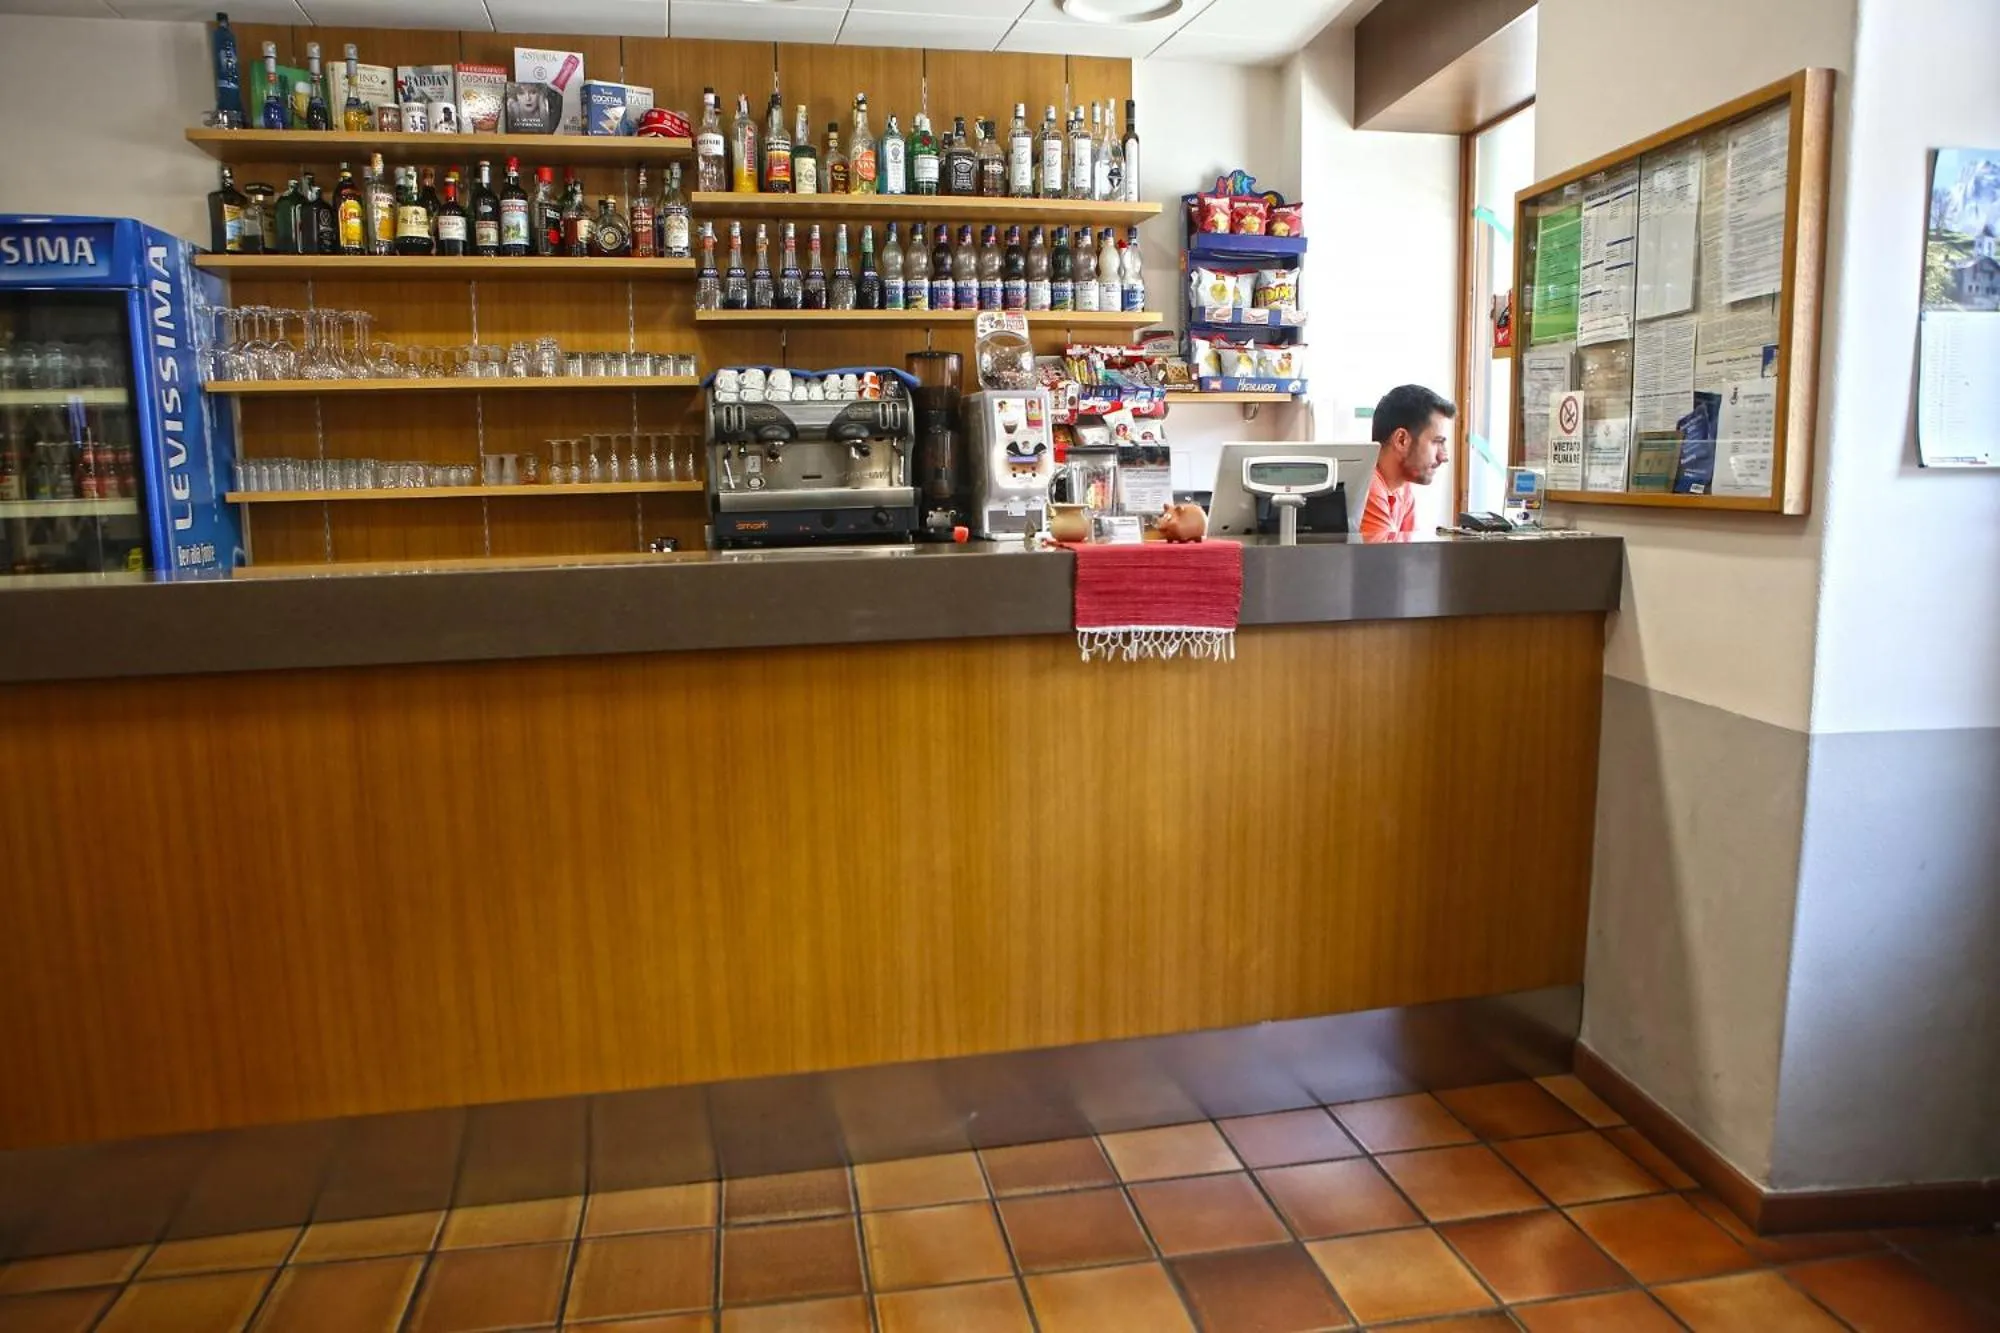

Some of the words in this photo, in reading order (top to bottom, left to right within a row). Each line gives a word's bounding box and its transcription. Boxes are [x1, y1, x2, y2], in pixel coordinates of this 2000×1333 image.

[405, 74, 449, 88] BARMAN
[0, 235, 96, 266] SIMA
[149, 245, 193, 531] LEVISSIMA
[1553, 441, 1581, 453] VIETATO
[1553, 454, 1581, 465] FUMARE
